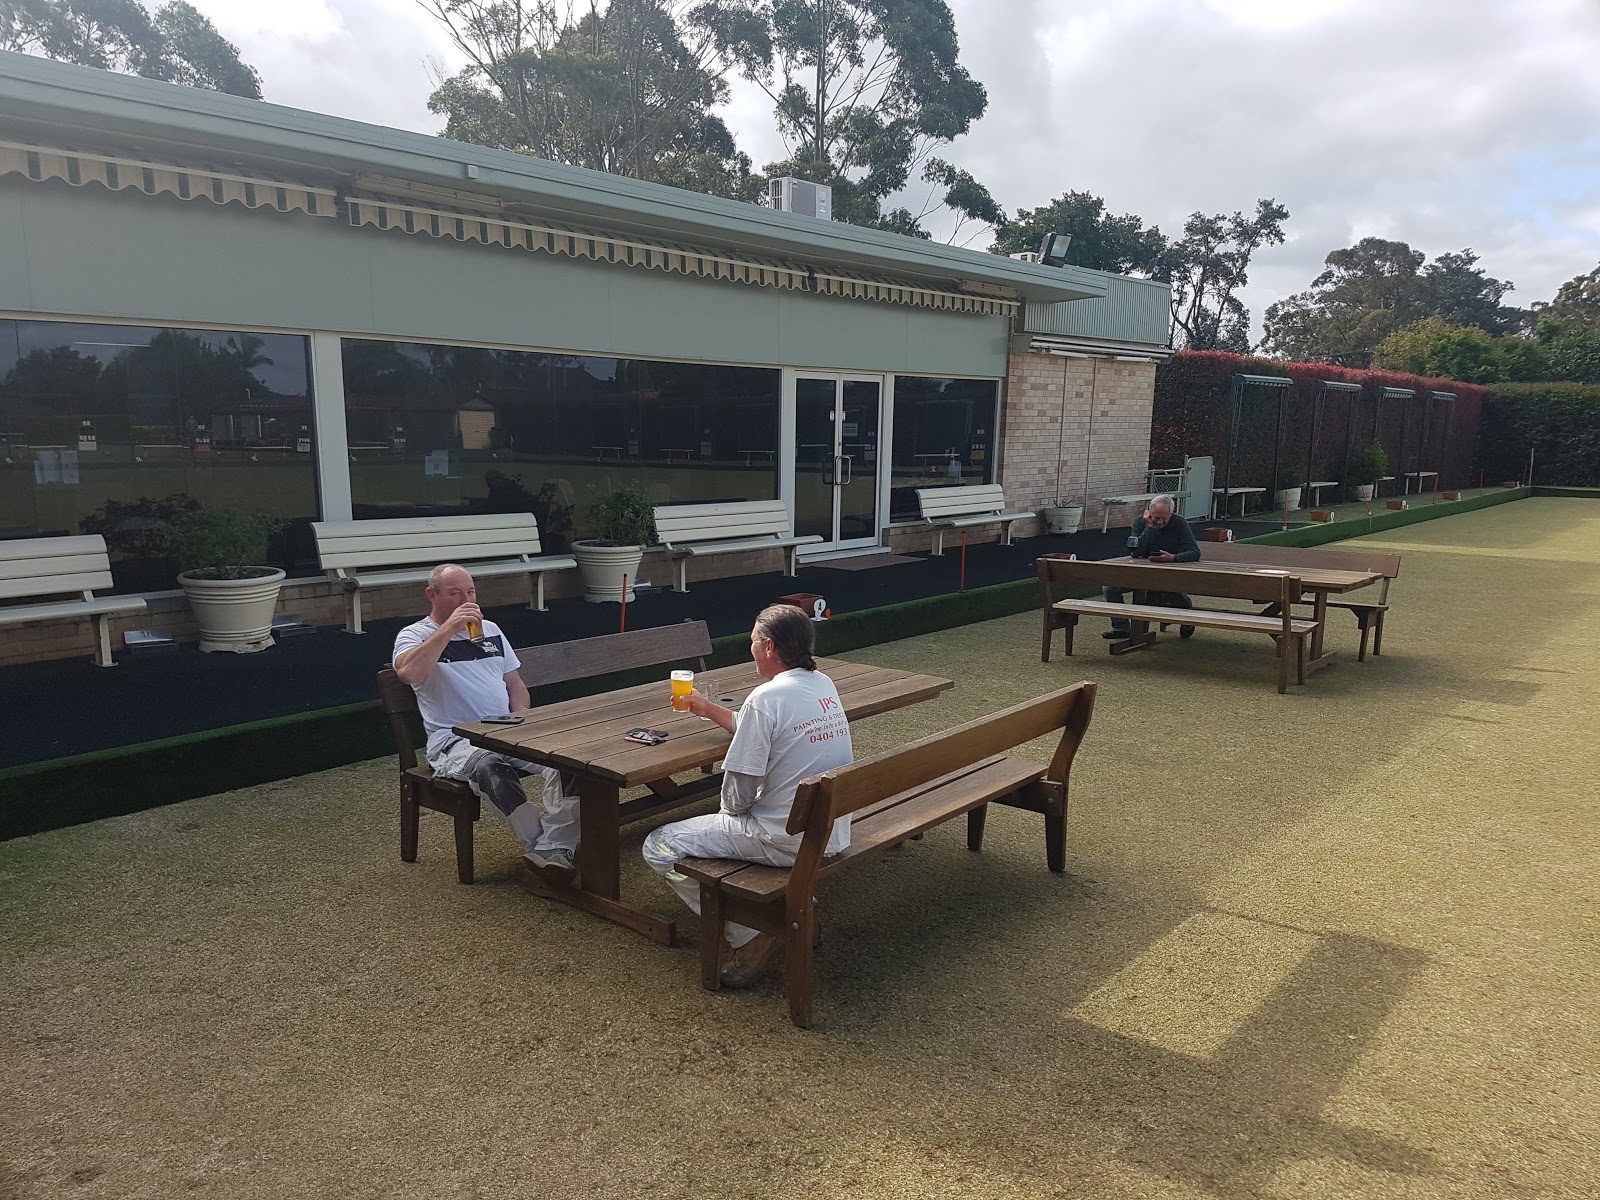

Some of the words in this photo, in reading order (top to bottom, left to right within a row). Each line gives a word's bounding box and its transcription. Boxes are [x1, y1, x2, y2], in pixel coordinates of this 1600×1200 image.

[818, 697, 838, 713] JPS
[793, 716, 828, 732] PAINTING
[810, 731, 834, 743] 0404
[836, 728, 848, 737] 193
